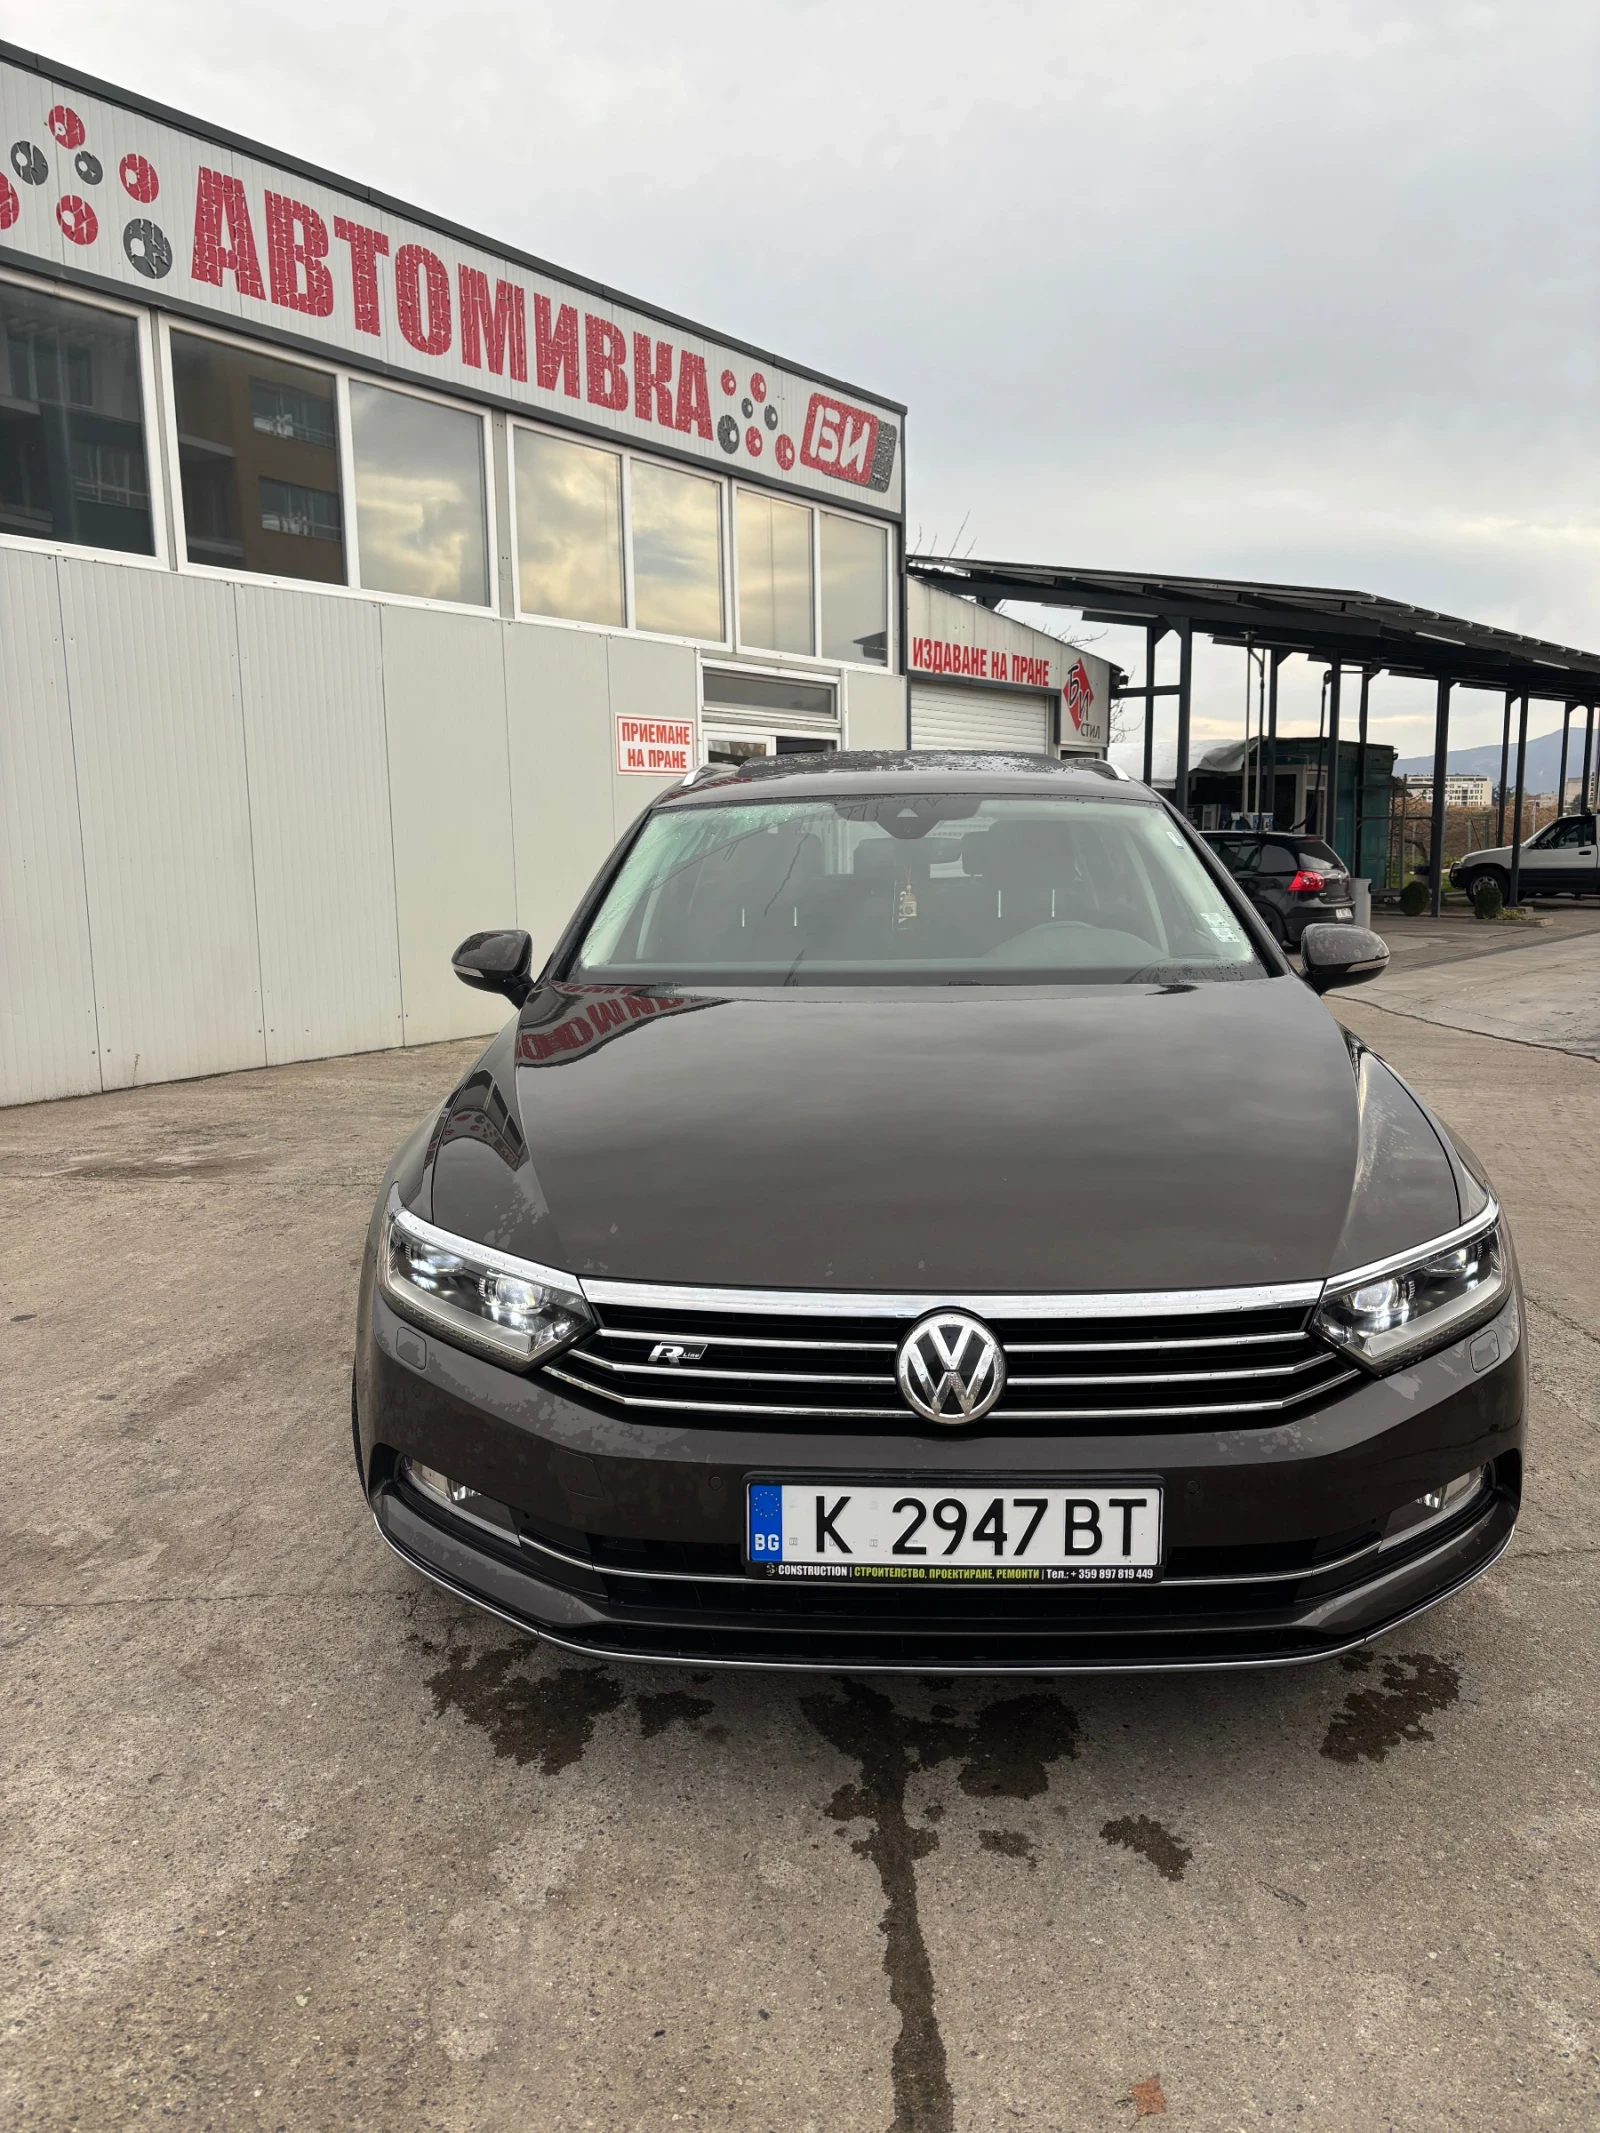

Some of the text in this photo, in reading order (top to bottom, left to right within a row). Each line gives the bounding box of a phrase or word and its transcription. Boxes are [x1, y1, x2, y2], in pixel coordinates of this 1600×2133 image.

[191, 165, 714, 442] АВТОМИВКА
[809, 404, 871, 474] БИ
[913, 636, 1050, 687] ИЗДАВАНЕ НА ПРАНЕ
[621, 722, 690, 745] ПРИЕМАНЕ
[1080, 725, 1101, 740] СТИЛ
[627, 748, 687, 769] НА ПРАНЕ
[815, 1495, 1148, 1557] K 2947 BT
[754, 1533, 780, 1551] BG
[778, 1564, 848, 1577] CONSTRUCTION
[854, 1566, 928, 1579] СТРОИТЕЛСТВО,
[929, 1567, 995, 1580] ПРОЕКТИРАНЕ,
[996, 1568, 1040, 1579] РЕМОНТИ
[1078, 1569, 1097, 1579] 359
[1099, 1569, 1116, 1579] 897
[1117, 1569, 1134, 1579] 819
[1135, 1569, 1154, 1579] 449
